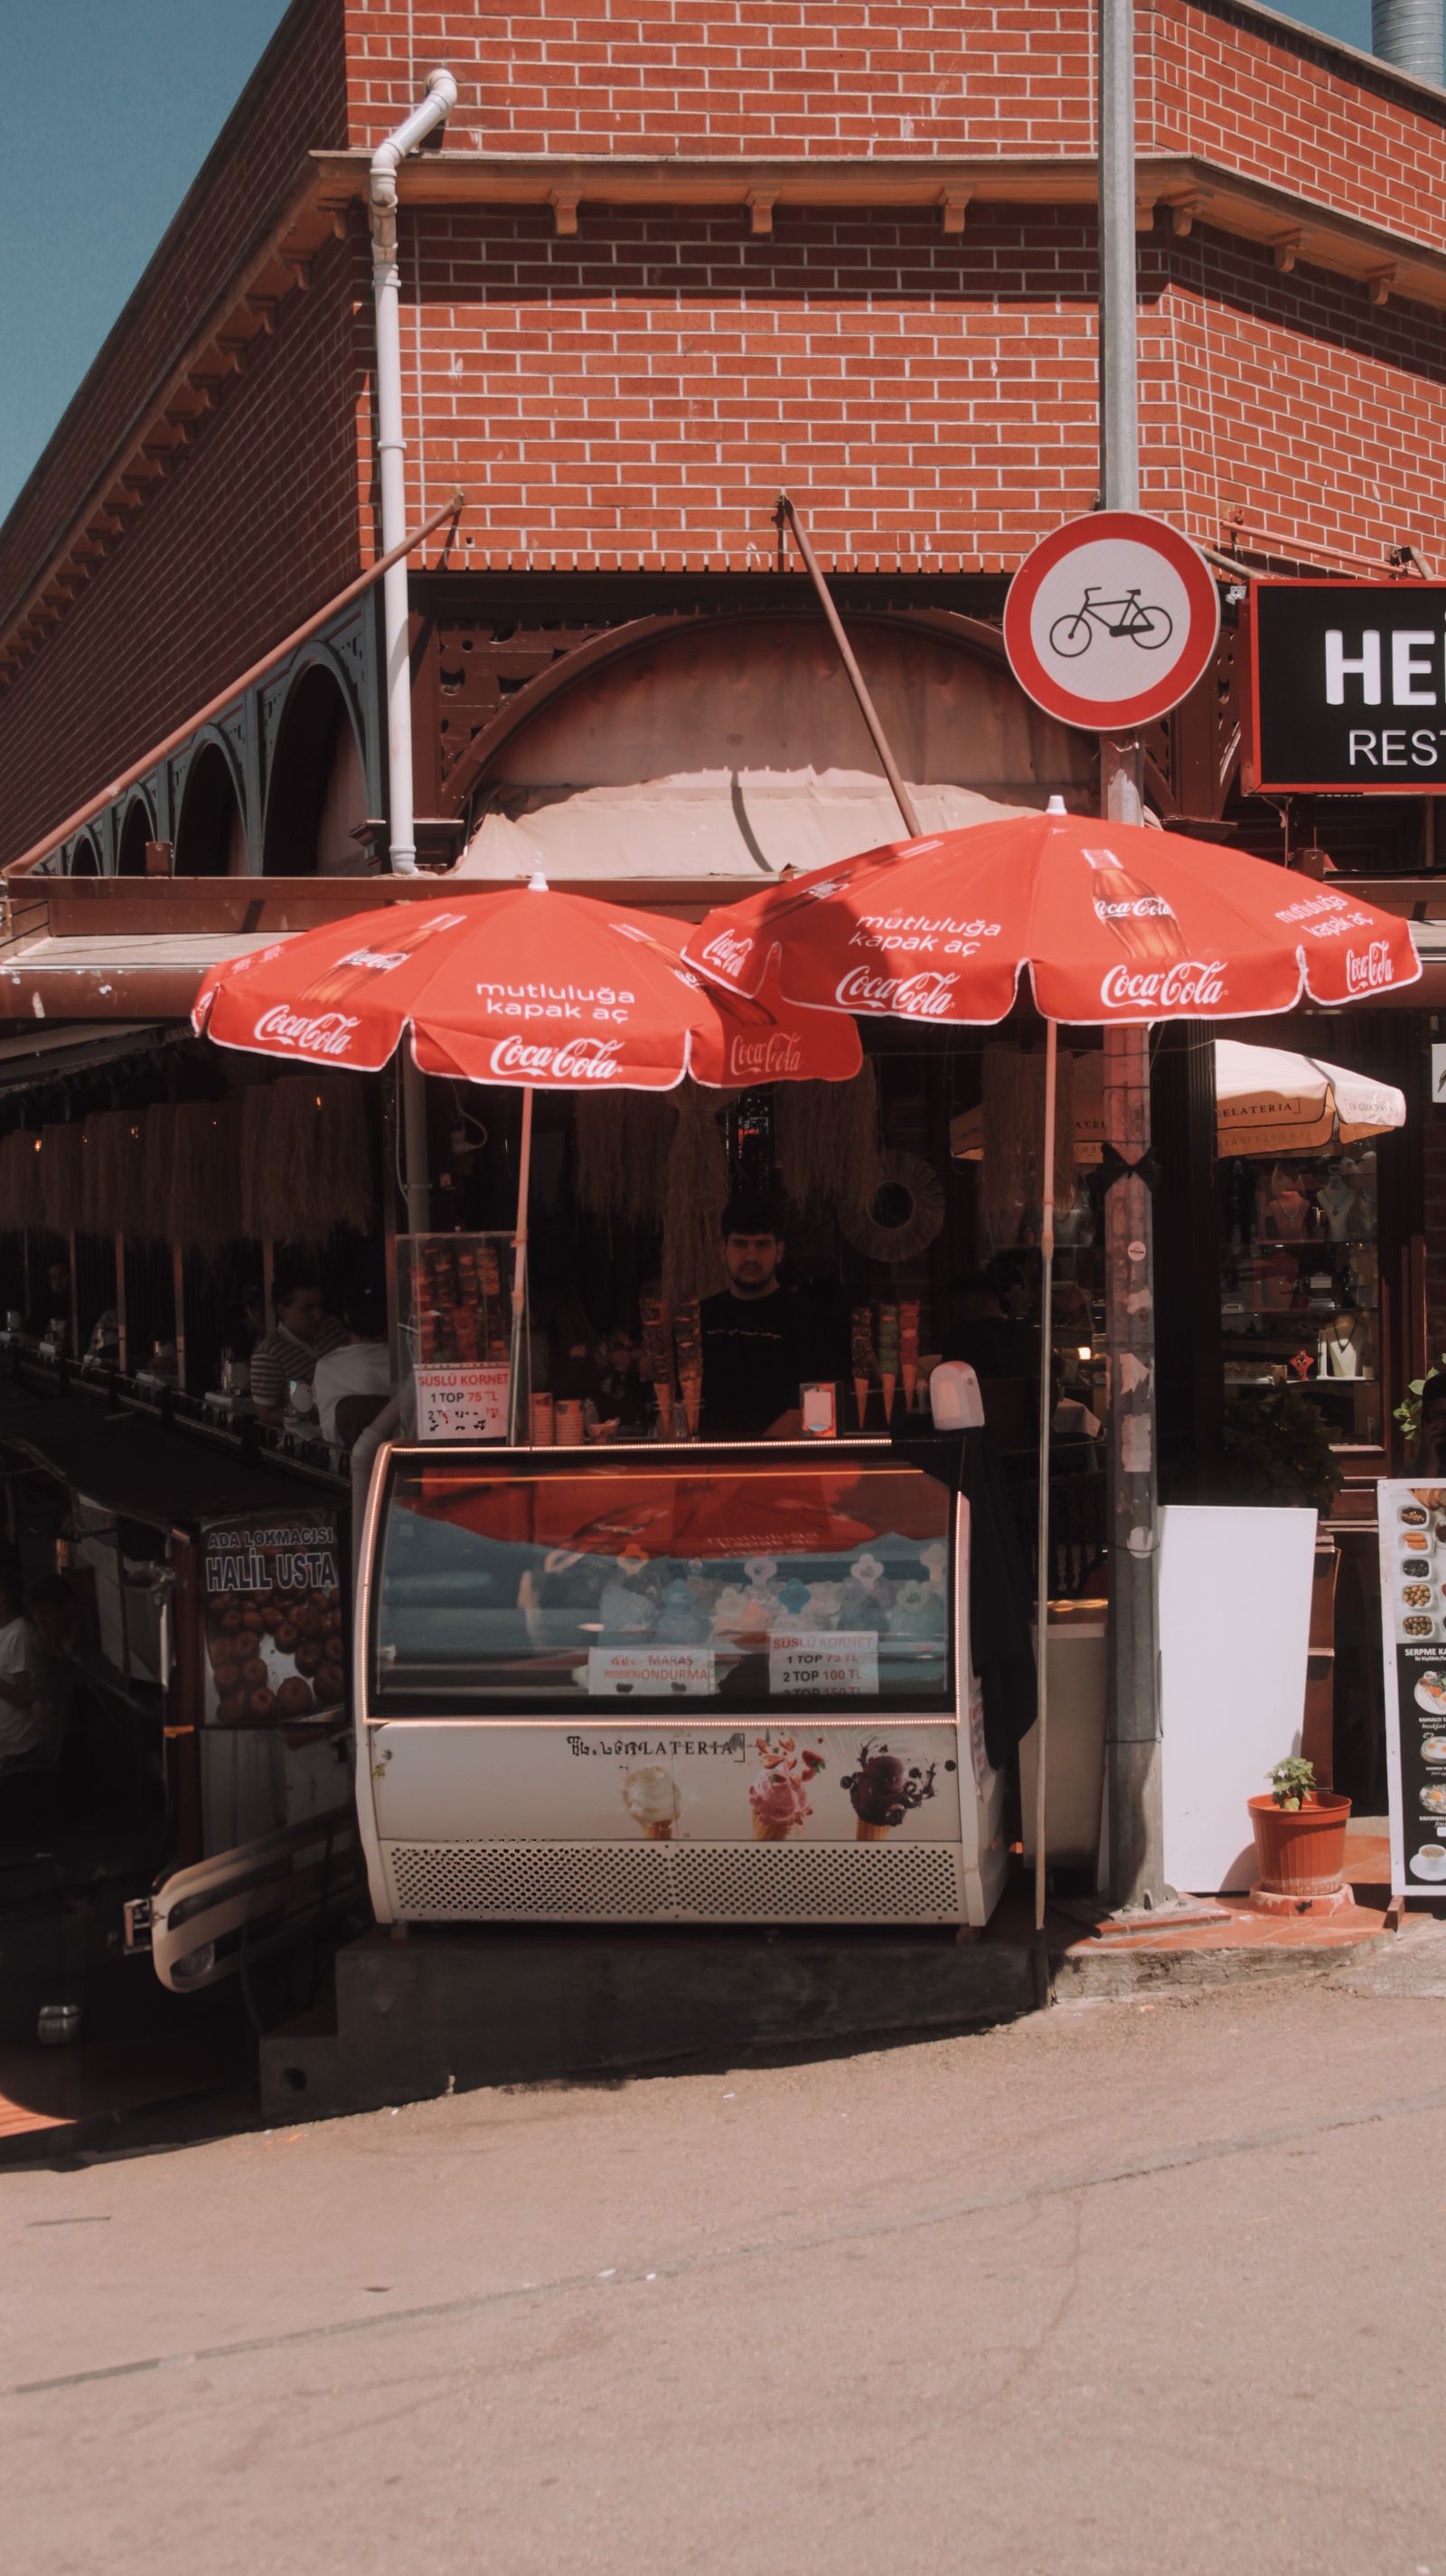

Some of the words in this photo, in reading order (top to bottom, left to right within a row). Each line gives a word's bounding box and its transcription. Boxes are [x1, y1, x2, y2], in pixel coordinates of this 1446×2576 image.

[1325, 629, 1446, 705] HE
[855, 916, 1001, 940] mutluluğa
[849, 932, 939, 952] kapak
[944, 940, 981, 958] aç
[476, 982, 635, 1005] mutluluğa
[486, 999, 581, 1020] kapak
[592, 1008, 629, 1024] aç
[460, 1373, 508, 1385] KORNET
[430, 1393, 436, 1403] 1
[439, 1392, 465, 1403] TOP
[467, 1392, 483, 1402] 75
[208, 1532, 241, 1548] ADA
[205, 1547, 272, 1592] HALİL
[277, 1552, 338, 1589] USTA
[787, 1655, 793, 1664] 1
[797, 1655, 822, 1664] TOP
[1405, 1647, 1436, 1657] SERPME
[647, 1654, 693, 1669] MARAŞ
[783, 1671, 790, 1682] 2
[793, 1670, 819, 1682] TOP
[823, 1669, 845, 1680] 100
[848, 1669, 863, 1679] TL
